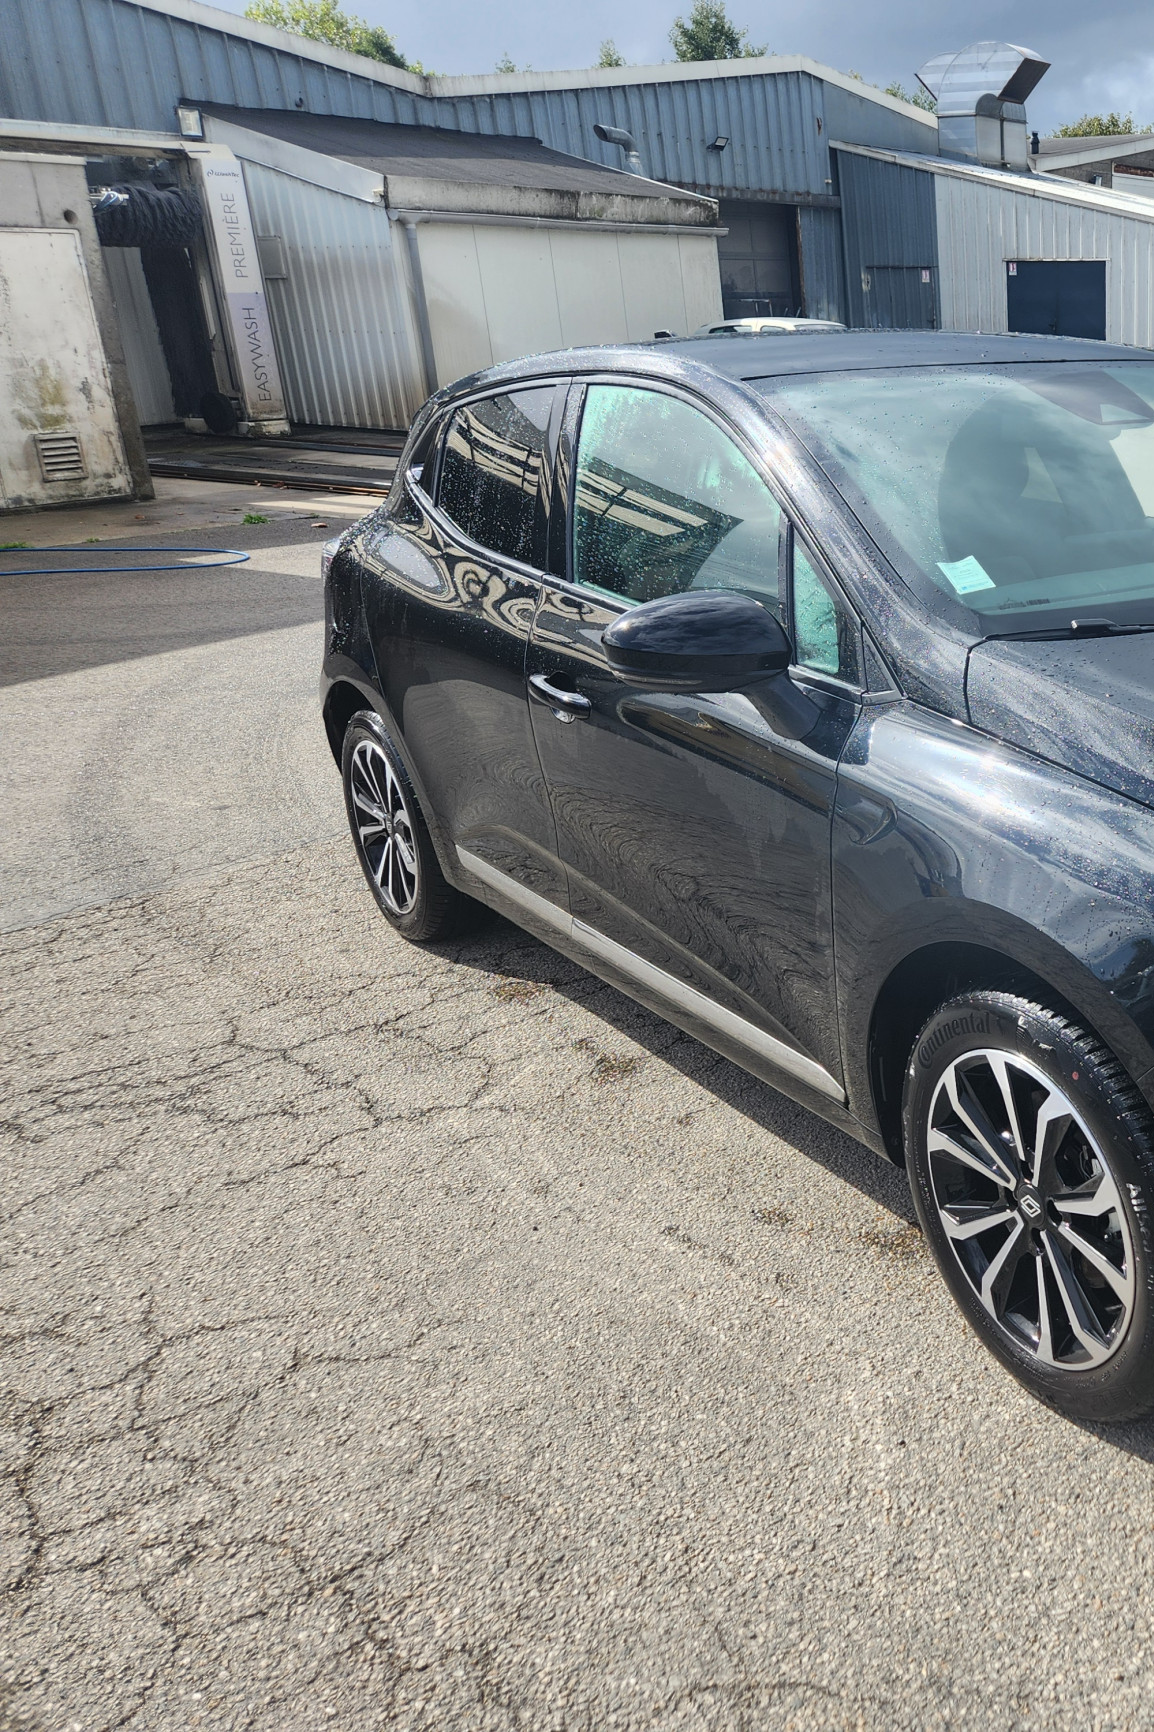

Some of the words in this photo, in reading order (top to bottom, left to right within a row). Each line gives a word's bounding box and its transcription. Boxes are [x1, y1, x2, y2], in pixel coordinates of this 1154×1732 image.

[220, 192, 249, 278] PREMIÈRE
[241, 307, 272, 402] EASYWASH
[917, 1011, 992, 1070] Continental
